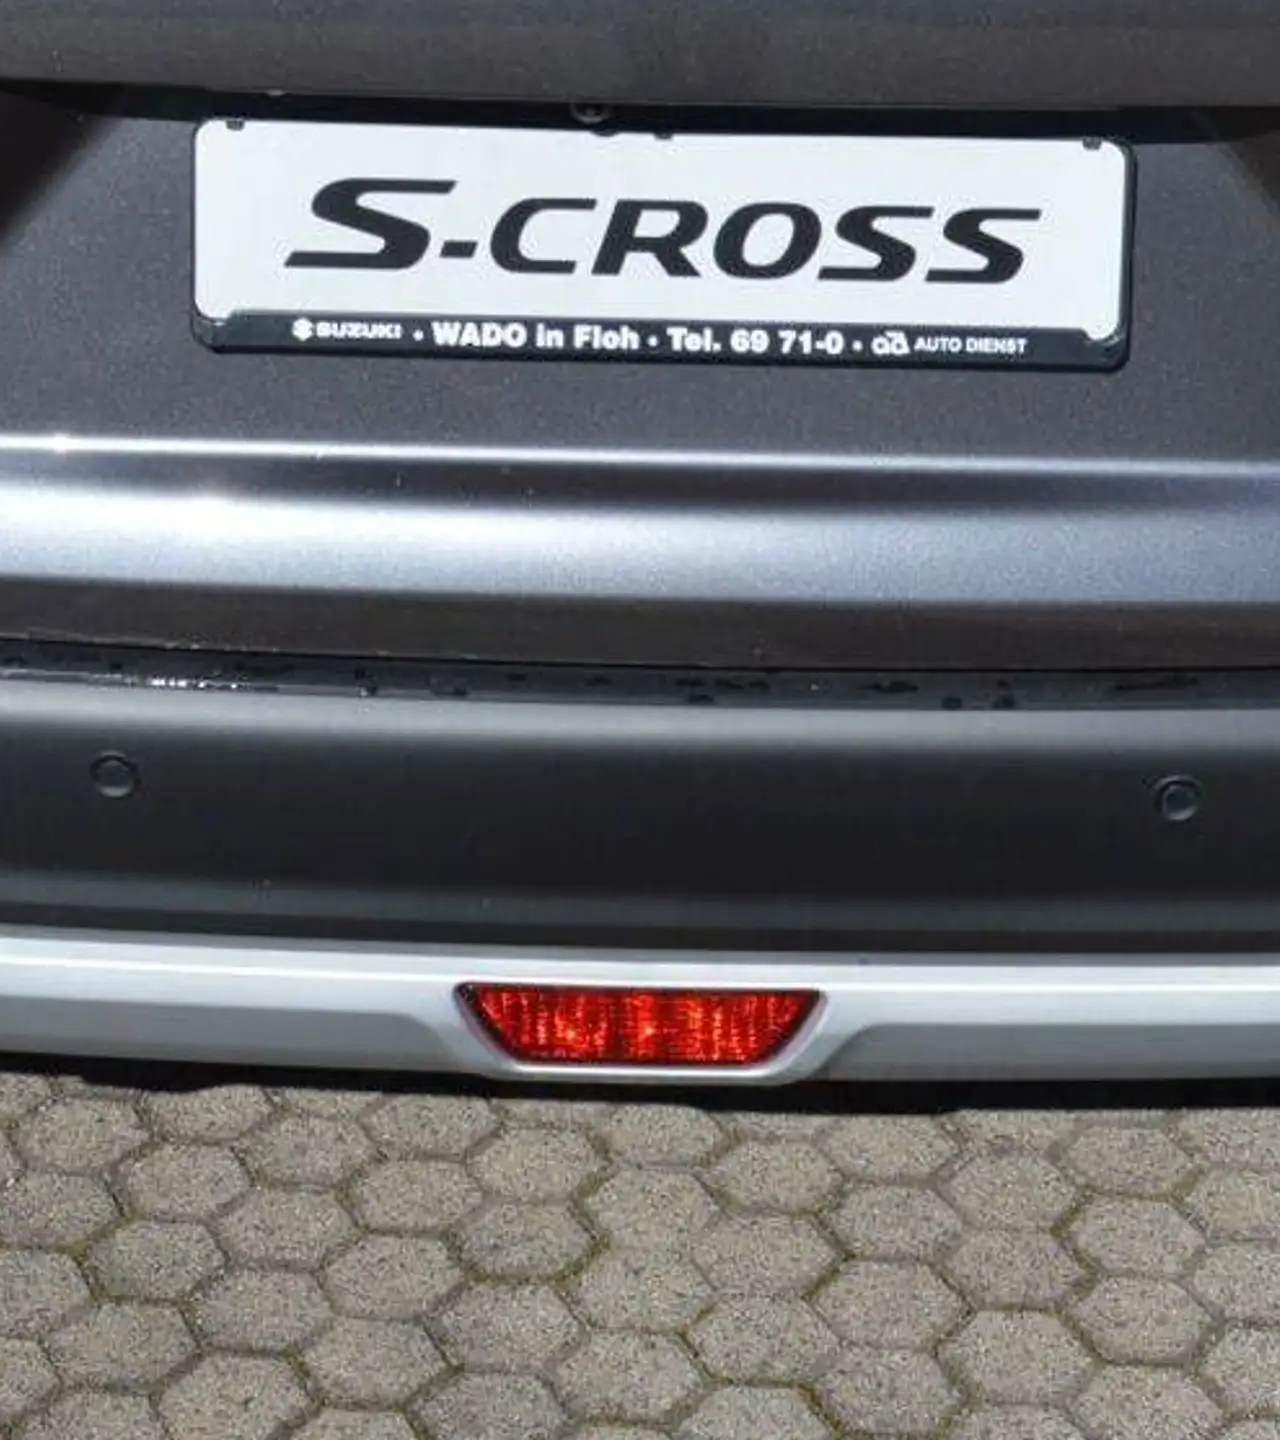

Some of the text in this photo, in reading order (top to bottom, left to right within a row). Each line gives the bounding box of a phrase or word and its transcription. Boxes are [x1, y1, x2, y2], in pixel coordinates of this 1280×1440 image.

[284, 177, 1041, 283] S-CROSS
[316, 321, 403, 340] SUZUKI
[431, 321, 527, 348] WADO
[536, 324, 564, 348] in
[573, 325, 639, 351] Floh
[667, 326, 721, 352] Tel.
[730, 328, 770, 354] 69
[778, 329, 844, 355] 71-0
[914, 337, 961, 352] AUTO
[966, 337, 1028, 354] DIENST
